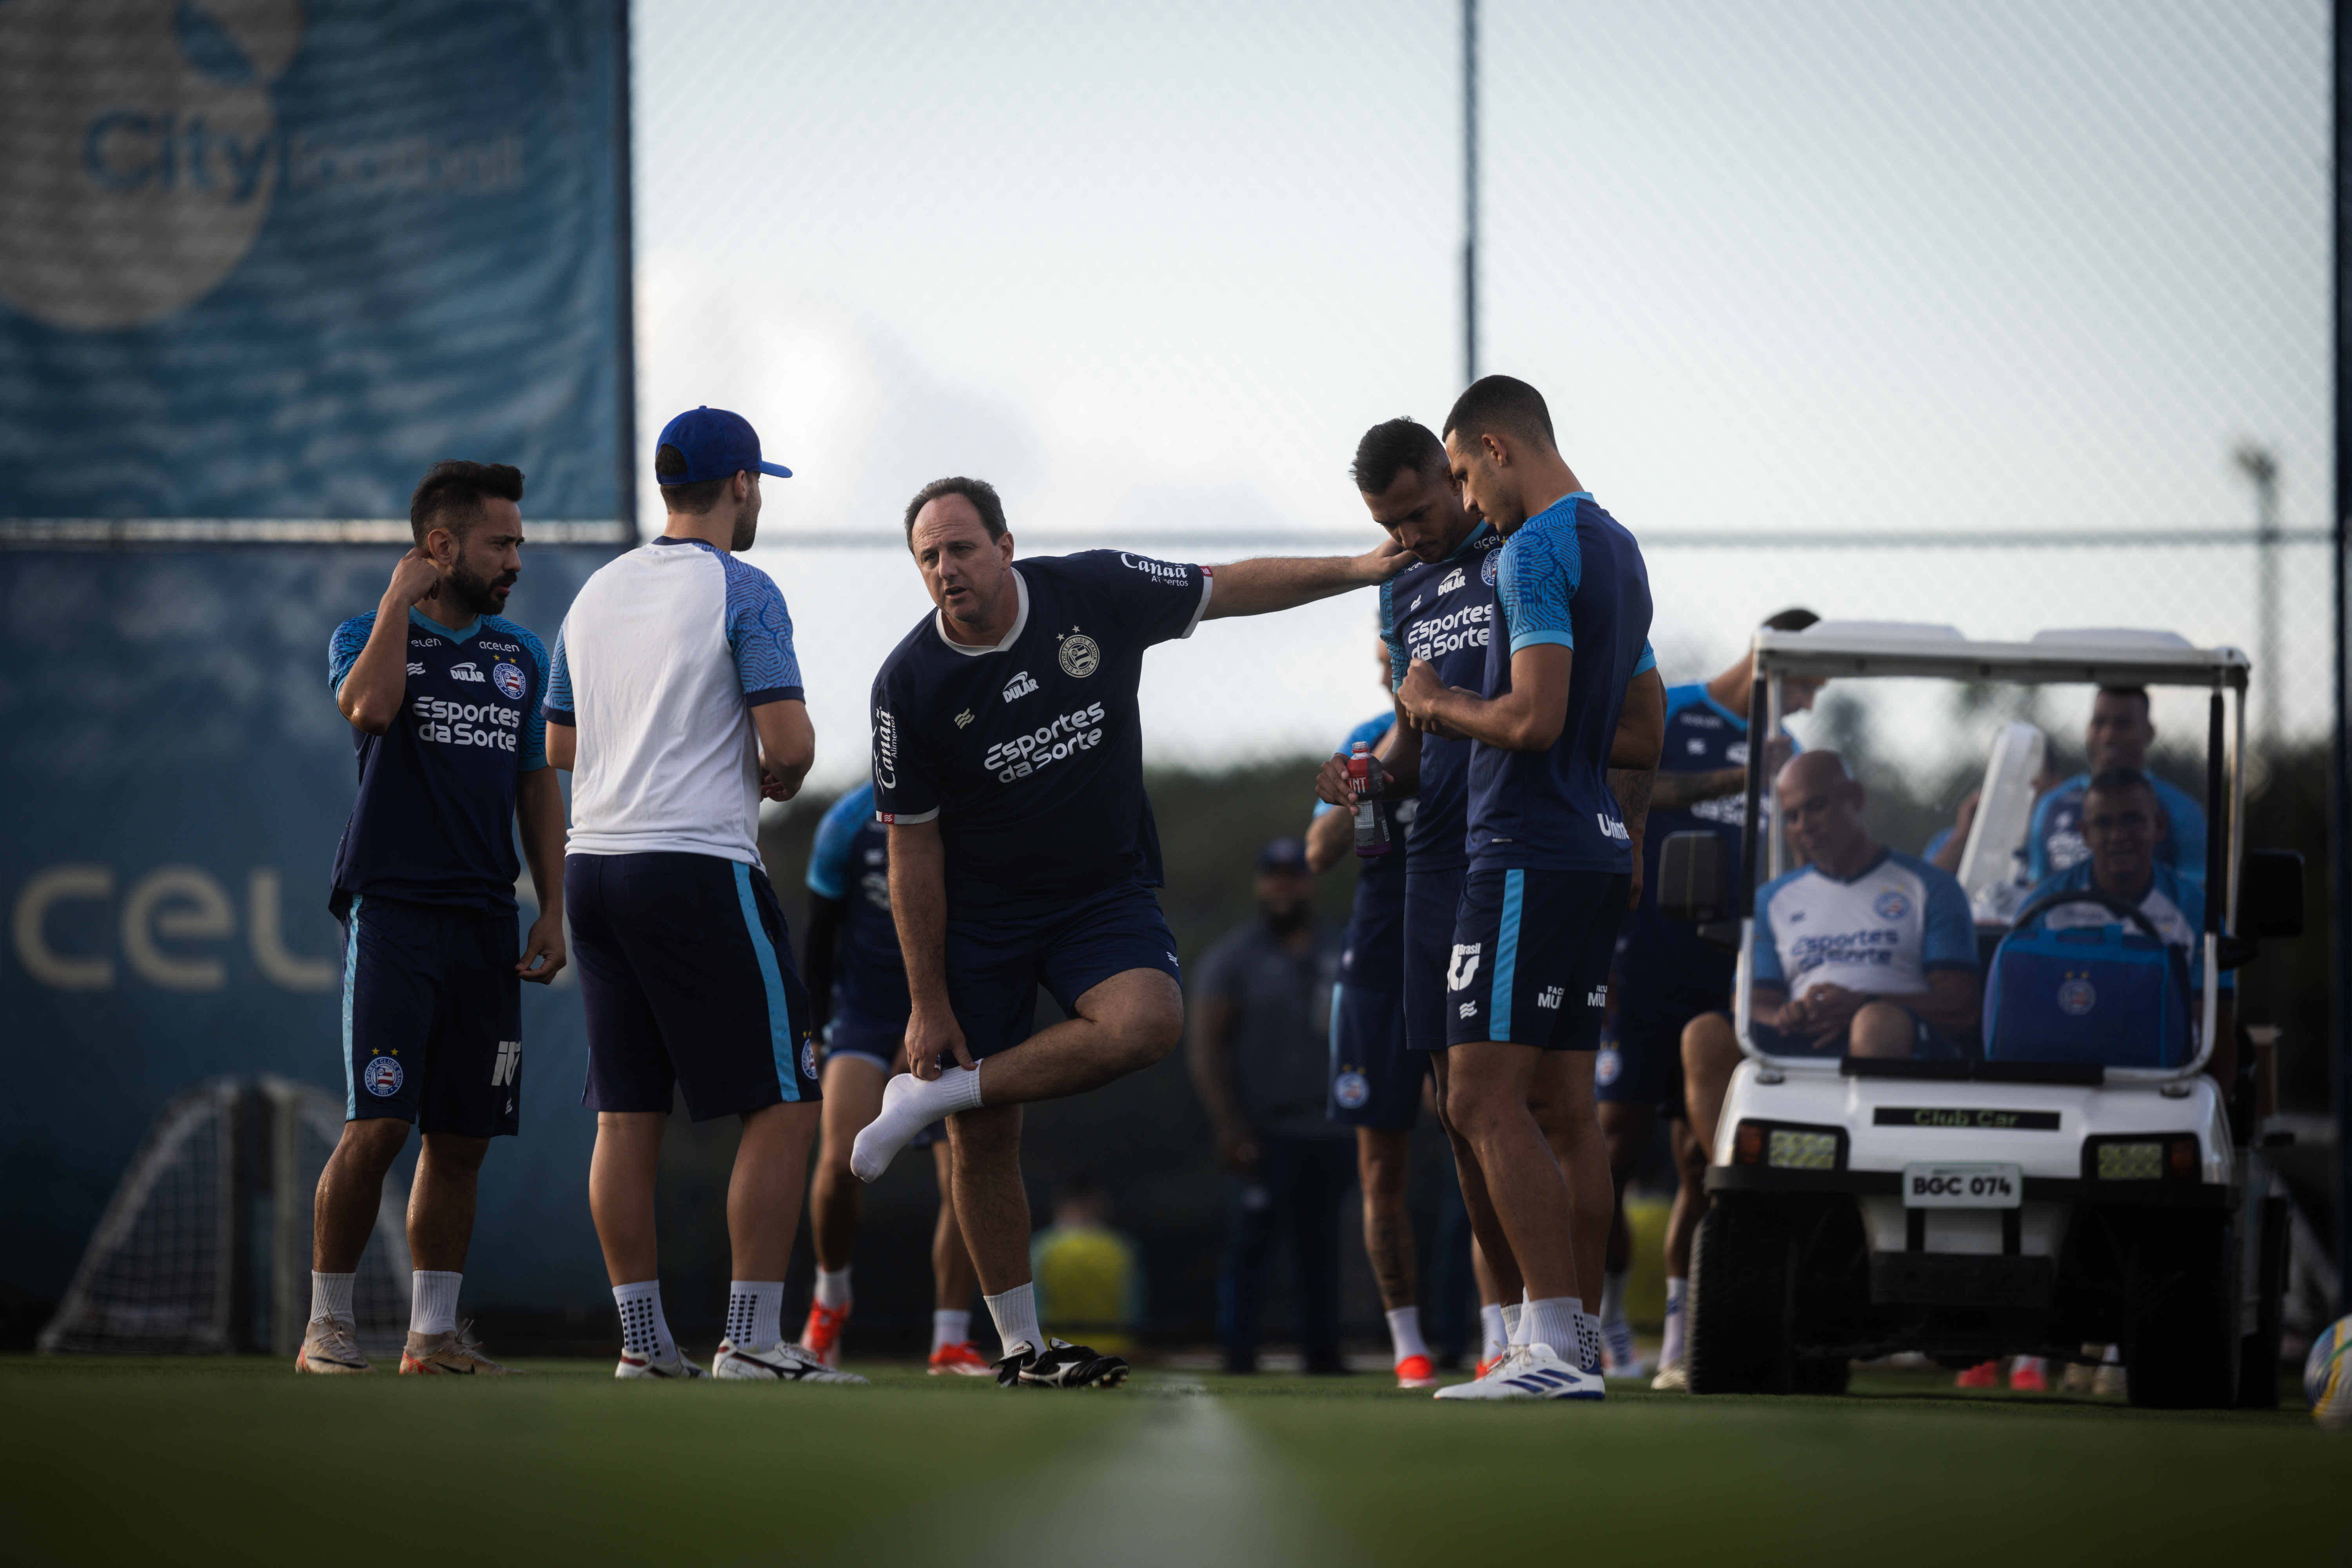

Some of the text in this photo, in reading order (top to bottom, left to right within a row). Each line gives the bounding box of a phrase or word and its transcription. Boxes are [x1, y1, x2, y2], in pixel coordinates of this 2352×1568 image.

[83, 108, 272, 205] City
[1121, 553, 1188, 578] Canaã
[1438, 575, 1465, 596] DULAR
[1408, 604, 1492, 644] Esportes
[479, 641, 520, 652] acelen
[1062, 645, 1074, 672] ESPORTE
[1088, 642, 1097, 660] BAHIA
[450, 669, 486, 682] DULAR
[495, 666, 503, 688] ESPORTE
[503, 665, 521, 674] CLUBE
[1002, 678, 1039, 703] DULAR
[412, 696, 520, 728] Esportes
[984, 701, 1105, 770] Esportes
[876, 708, 897, 789] Canaã
[1348, 777, 1366, 793] TNT
[12, 866, 338, 992] cel
[1459, 943, 1481, 955] Brasil
[367, 1060, 379, 1087] ESPORTE
[379, 1059, 399, 1069] CLUBE
[1913, 1110, 2019, 1127] Club Car
[1913, 1177, 2011, 1195] BGC 074
